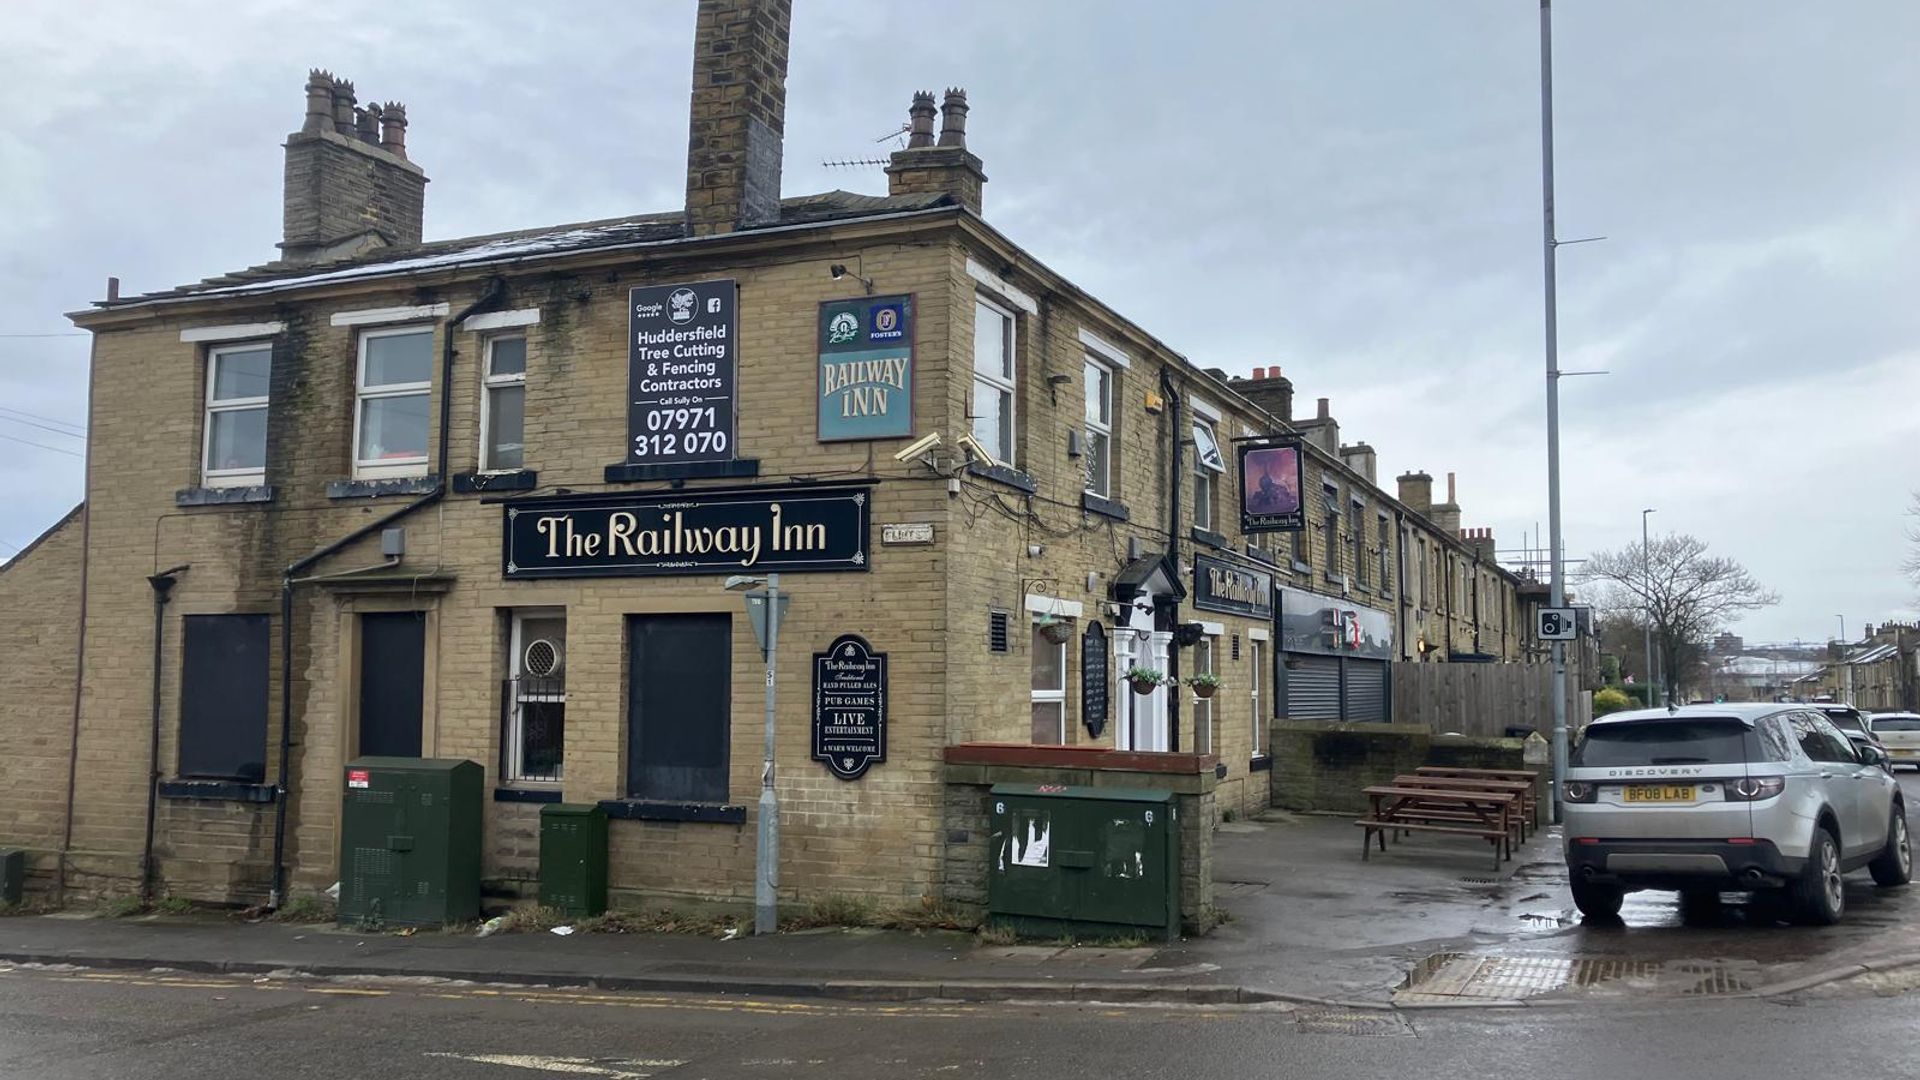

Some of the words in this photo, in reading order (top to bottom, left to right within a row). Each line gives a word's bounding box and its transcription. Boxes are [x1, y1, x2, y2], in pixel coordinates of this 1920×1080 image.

[636, 303, 662, 313] Google
[638, 324, 726, 344] Huddersfield
[871, 331, 901, 339] FOSTER'S
[639, 347, 669, 360] Tree
[674, 343, 725, 358] Cutting
[647, 363, 658, 376] &
[663, 359, 715, 375] Fencing
[640, 378, 722, 393] Contractors
[824, 358, 908, 398] RAILWAY
[674, 397, 690, 405] Sully
[842, 387, 889, 417] INN
[647, 407, 715, 431] 07971
[635, 434, 676, 456] 312
[684, 431, 726, 454] 070
[537, 514, 600, 558] The
[608, 511, 760, 567] Railway
[771, 503, 826, 551] Inn
[1209, 567, 1225, 598] The
[1226, 570, 1256, 613] Railway
[825, 661, 838, 670] The
[839, 660, 865, 673] Railway
[866, 661, 875, 670] Inn
[825, 697, 842, 705] PUB
[845, 697, 874, 705] GAMES
[834, 713, 865, 725] LIVE
[825, 726, 873, 734] ENTERTAINMENT
[1664, 788, 1690, 800] LAB
[996, 803, 1004, 813] 6
